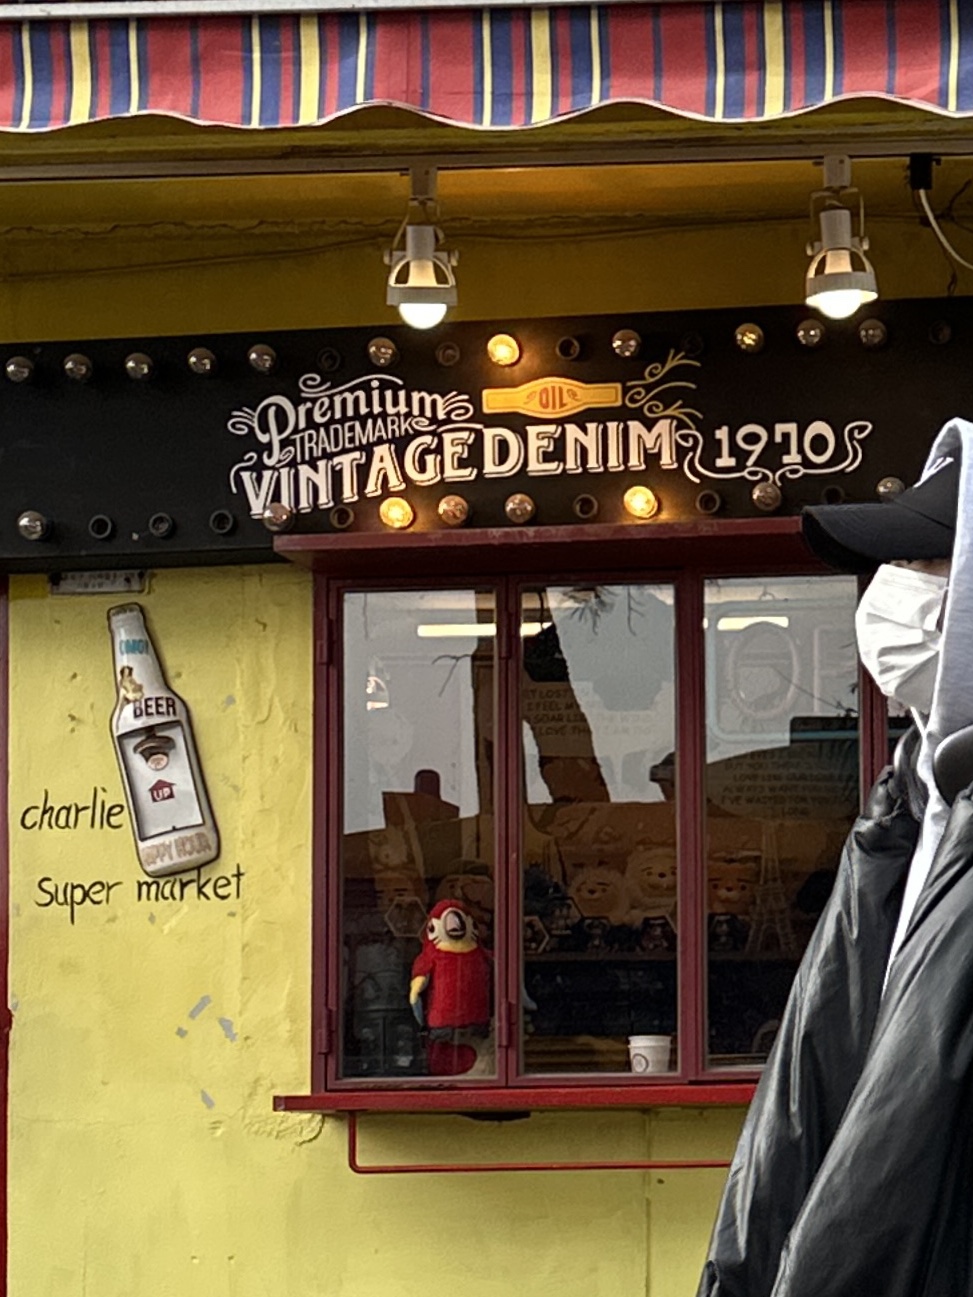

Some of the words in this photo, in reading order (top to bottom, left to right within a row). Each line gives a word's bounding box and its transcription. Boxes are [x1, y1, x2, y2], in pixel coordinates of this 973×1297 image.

[538, 385, 568, 411] OIL
[253, 379, 448, 467] Premium
[290, 415, 414, 463] TRADEMARK
[714, 420, 836, 468] 1970
[240, 430, 478, 520] VINTAGE
[482, 418, 679, 479] DENIM
[133, 695, 177, 719] BEER
[20, 786, 124, 830] charlie
[153, 787, 171, 801] UP
[34, 876, 123, 925] Super
[136, 862, 245, 902] market
